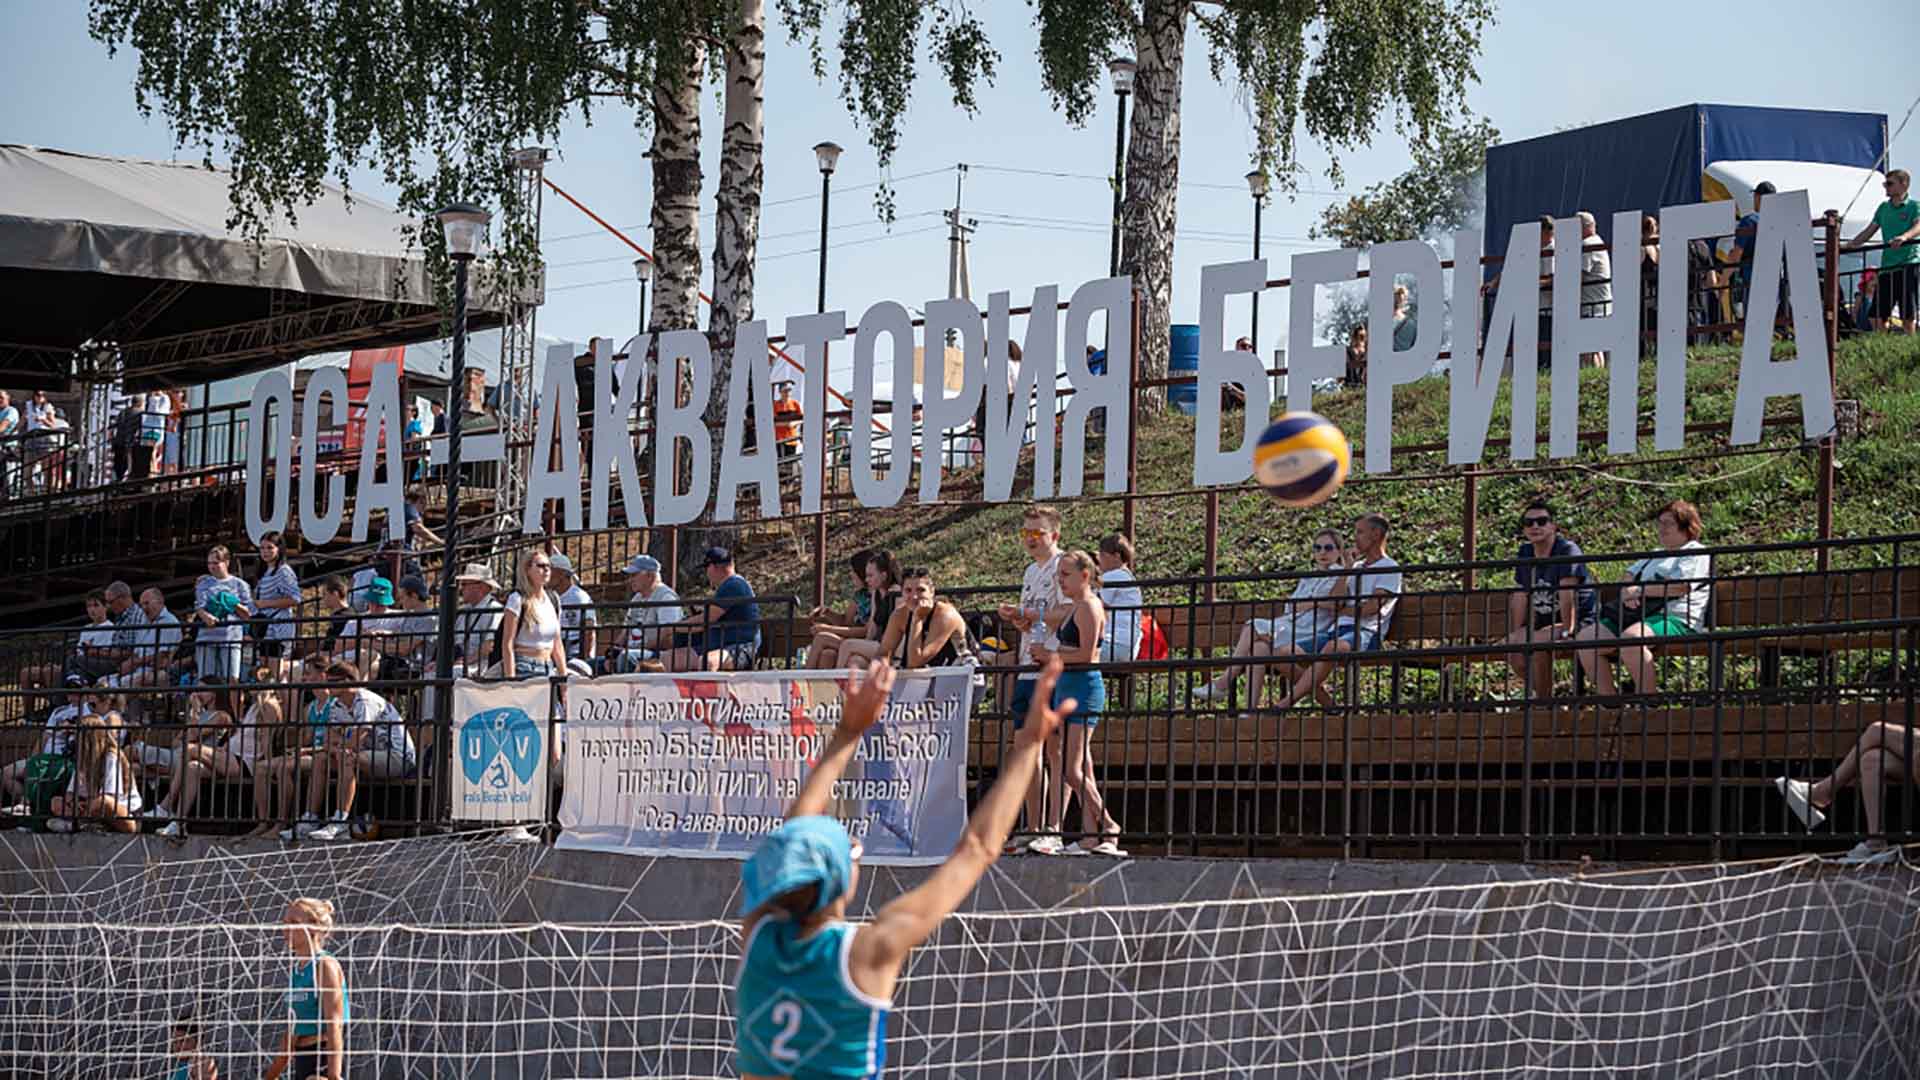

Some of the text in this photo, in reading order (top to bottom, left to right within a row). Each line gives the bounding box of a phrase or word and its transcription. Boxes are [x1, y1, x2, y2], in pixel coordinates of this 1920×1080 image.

[245, 361, 406, 547] ОСА
[524, 275, 1132, 535] АКВАТОРИЯ
[1194, 189, 1836, 487] БЕРИНГА
[580, 698, 622, 721] ООО
[816, 695, 960, 728] офальный
[580, 728, 952, 763] партнер ОБЪЕДИНЕННОЙ АЛЬСКОЙ
[716, 769, 769, 798] ЛИГИ
[775, 777, 800, 798] на
[830, 778, 912, 800] стивале
[771, 1001, 802, 1060] 2
